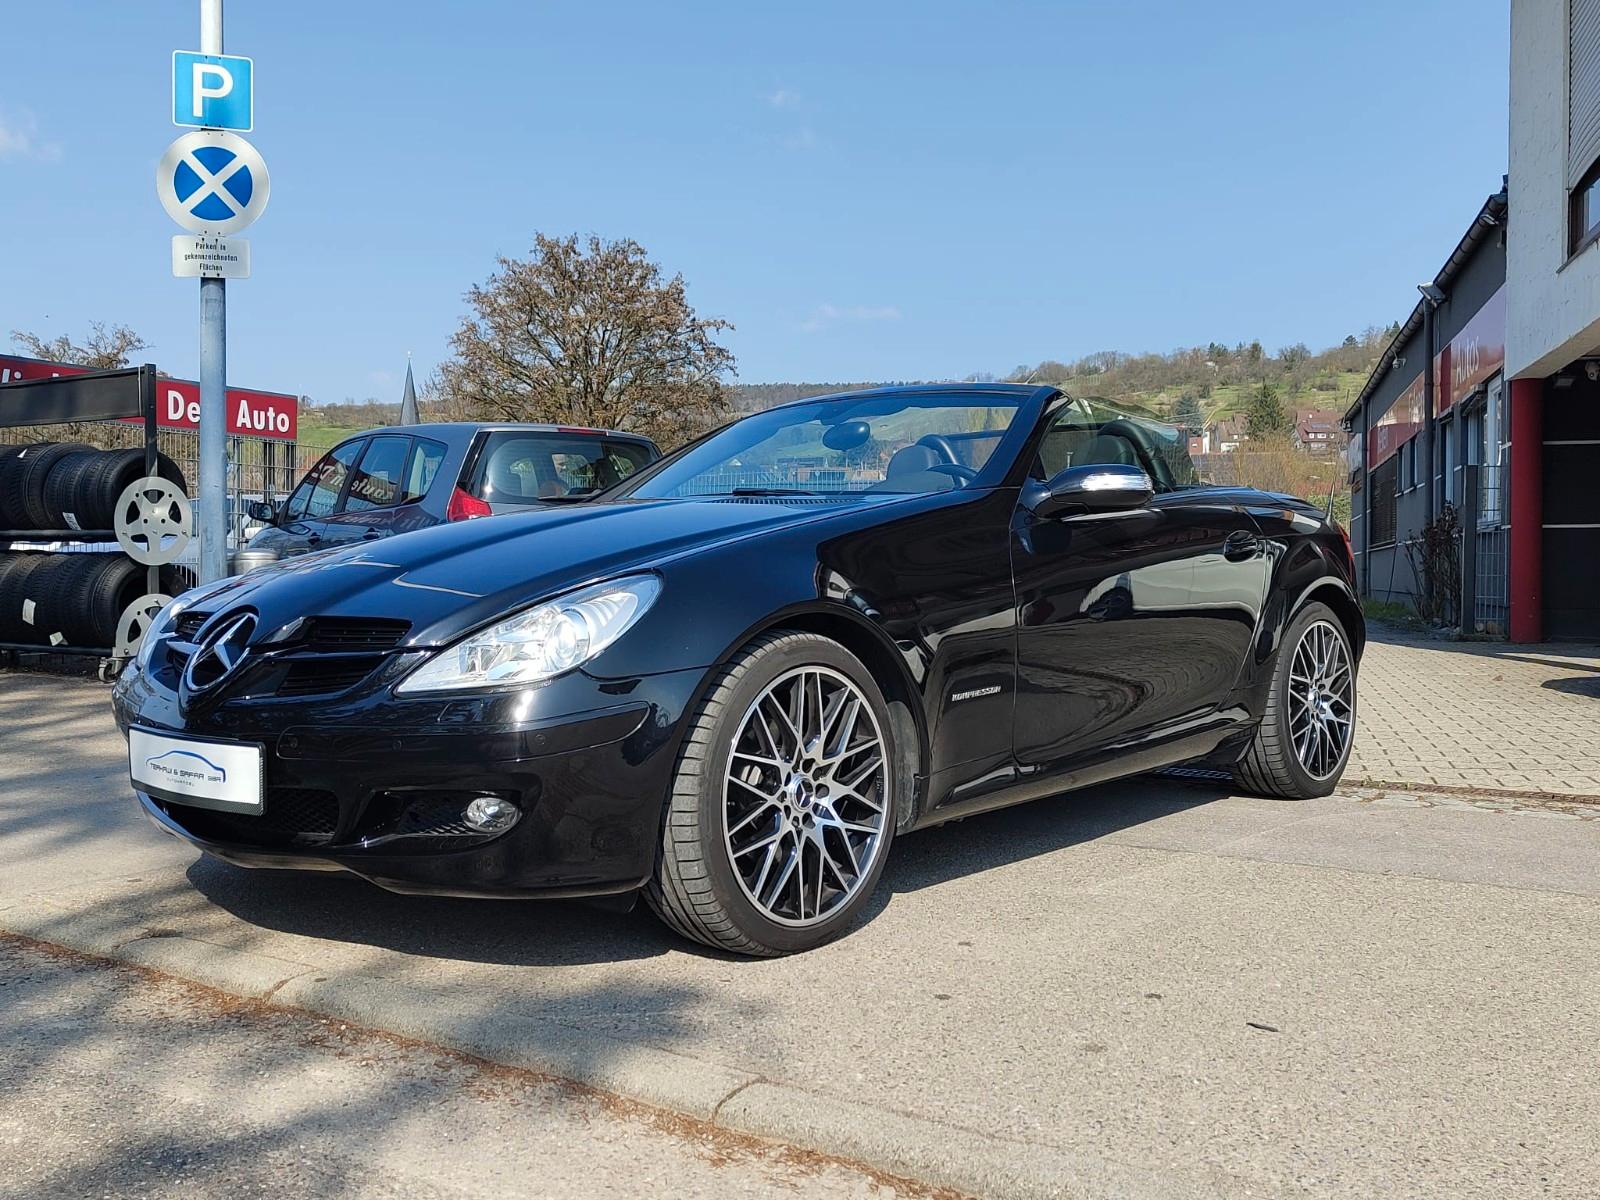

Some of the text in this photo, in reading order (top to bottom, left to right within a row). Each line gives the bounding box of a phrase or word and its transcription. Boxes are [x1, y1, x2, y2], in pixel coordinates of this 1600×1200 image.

[192, 63, 233, 118] P
[195, 242, 217, 250] Parken
[236, 400, 290, 433] Auto
